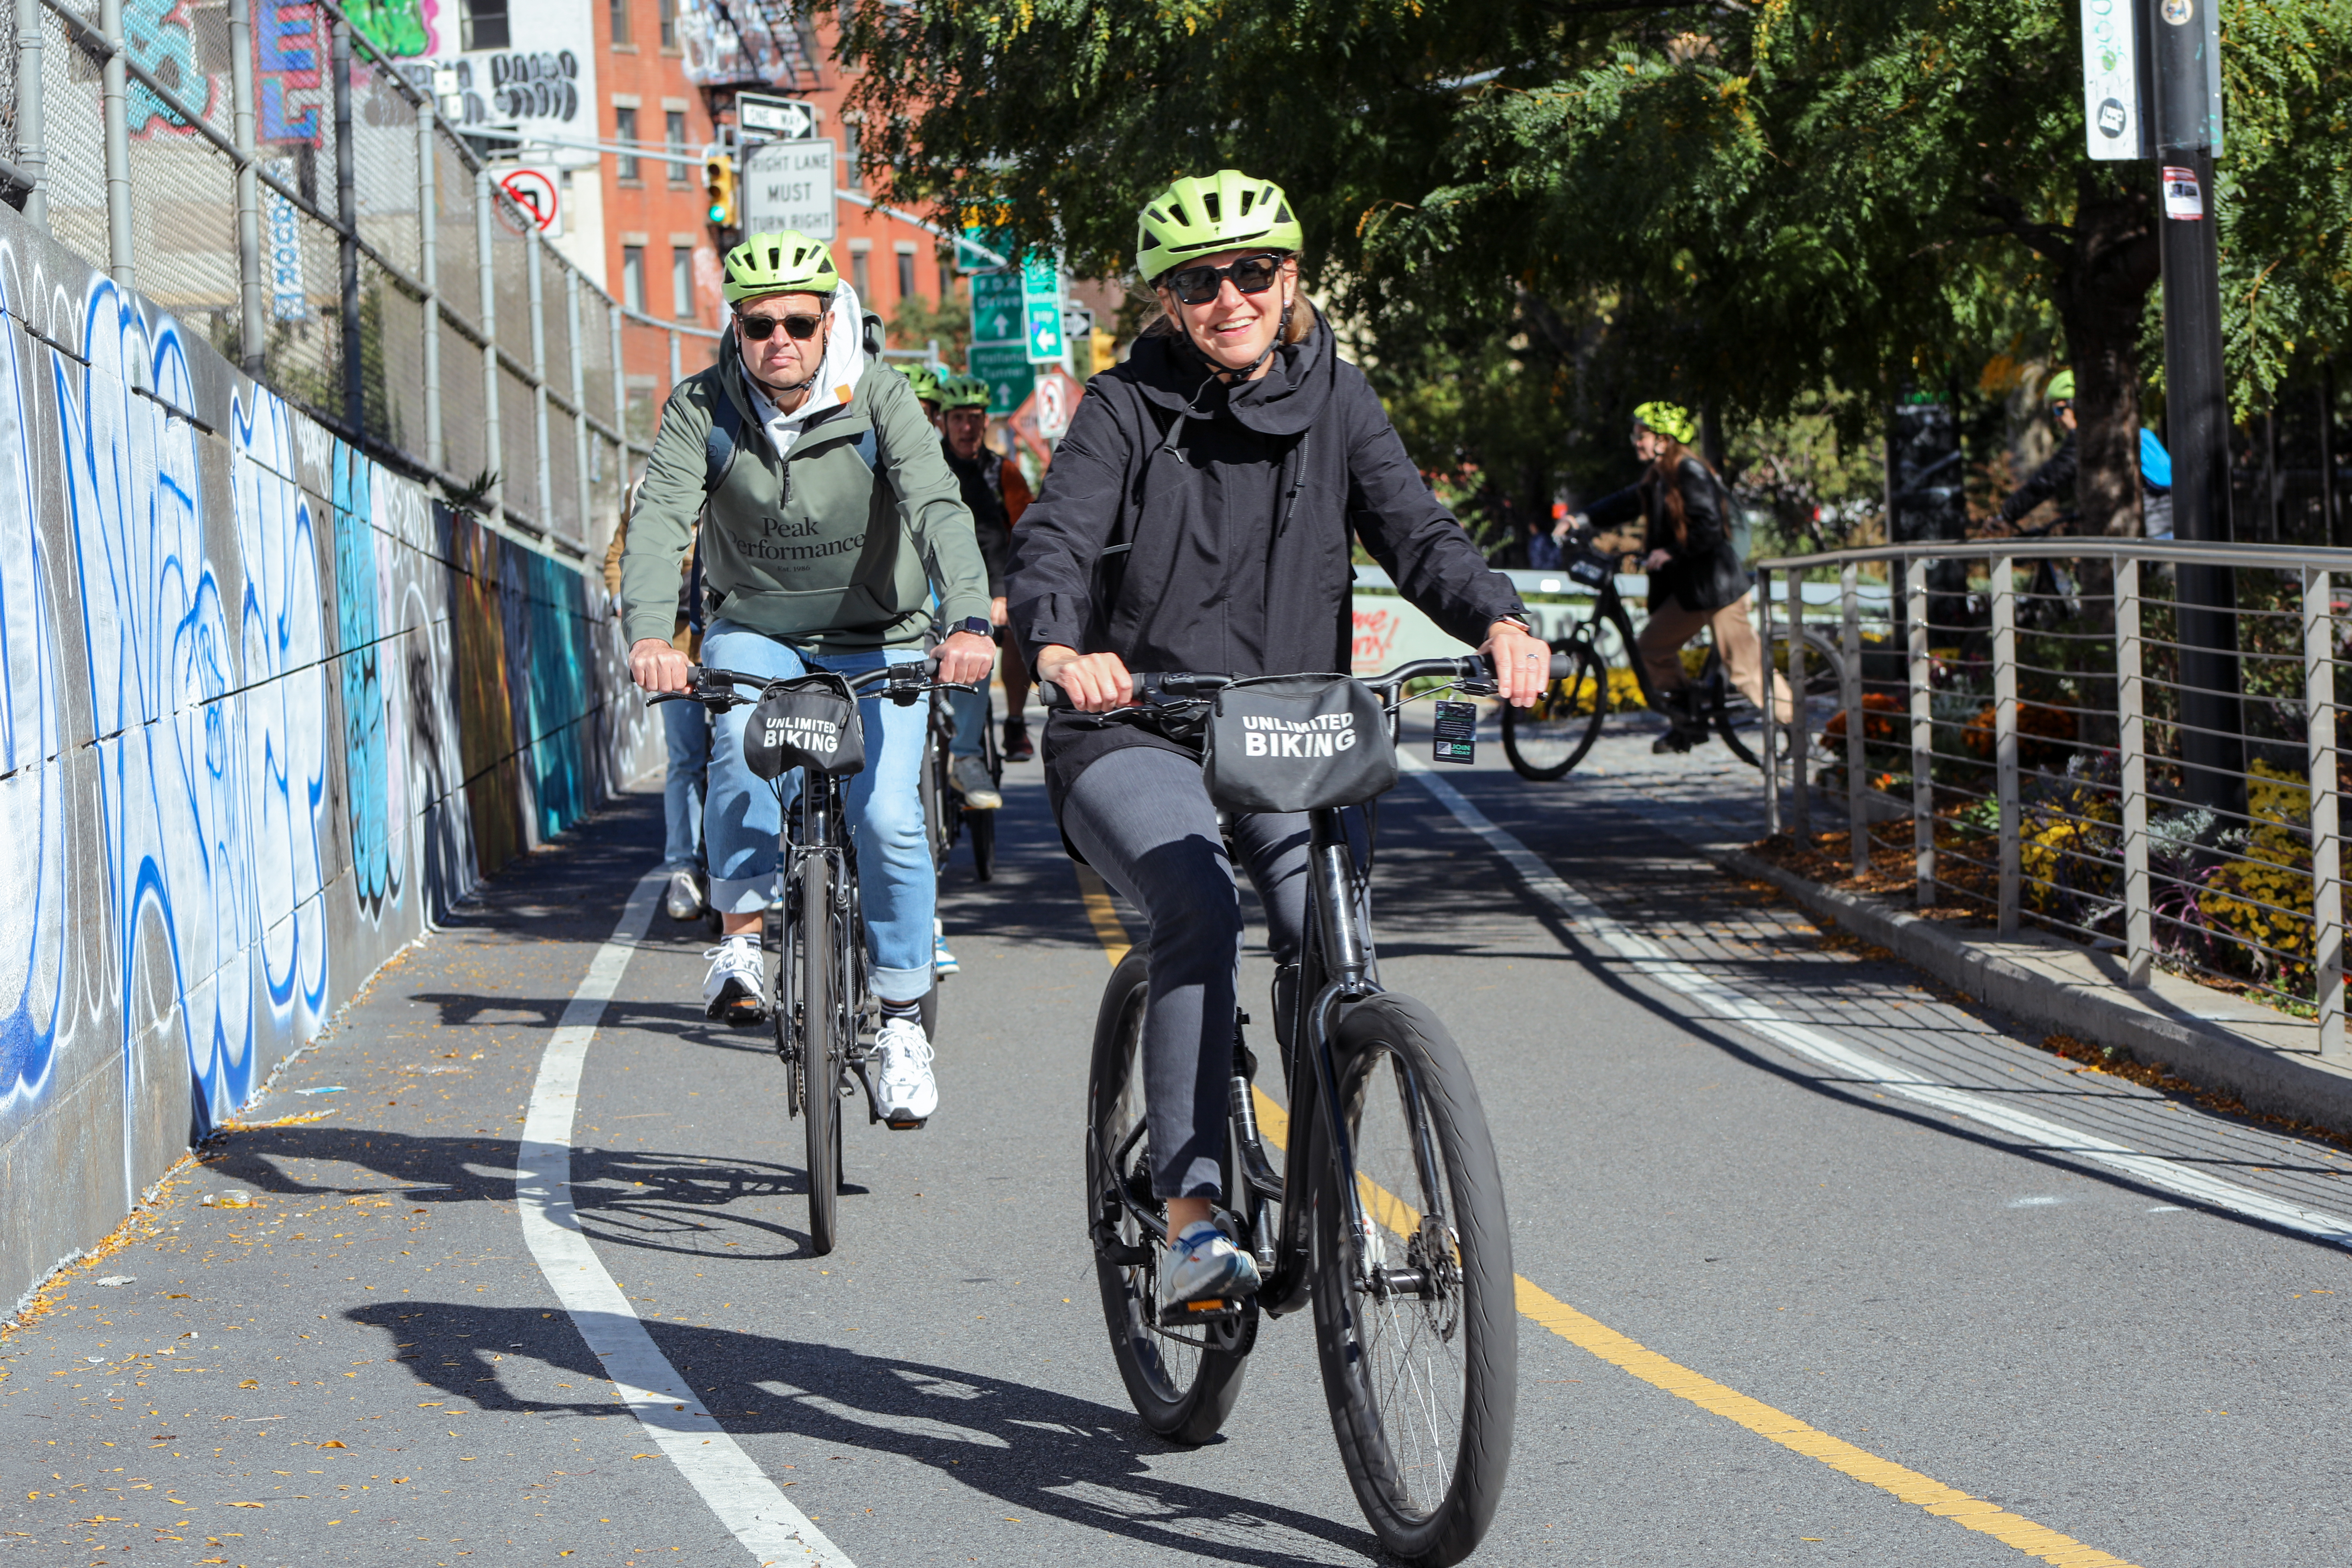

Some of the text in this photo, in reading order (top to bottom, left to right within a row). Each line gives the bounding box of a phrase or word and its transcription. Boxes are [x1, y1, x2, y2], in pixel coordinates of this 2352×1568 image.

[749, 108, 801, 126] ONE WAY
[751, 153, 828, 172] RIGHT LANE
[767, 182, 812, 202] MUST
[753, 213, 829, 231] TURN RIGHT
[761, 517, 820, 538] Peak
[766, 717, 836, 734] UNLIMITED
[1242, 712, 1354, 733] UNLIMITED
[763, 729, 838, 753] BIKING
[1245, 728, 1357, 757] BIKING
